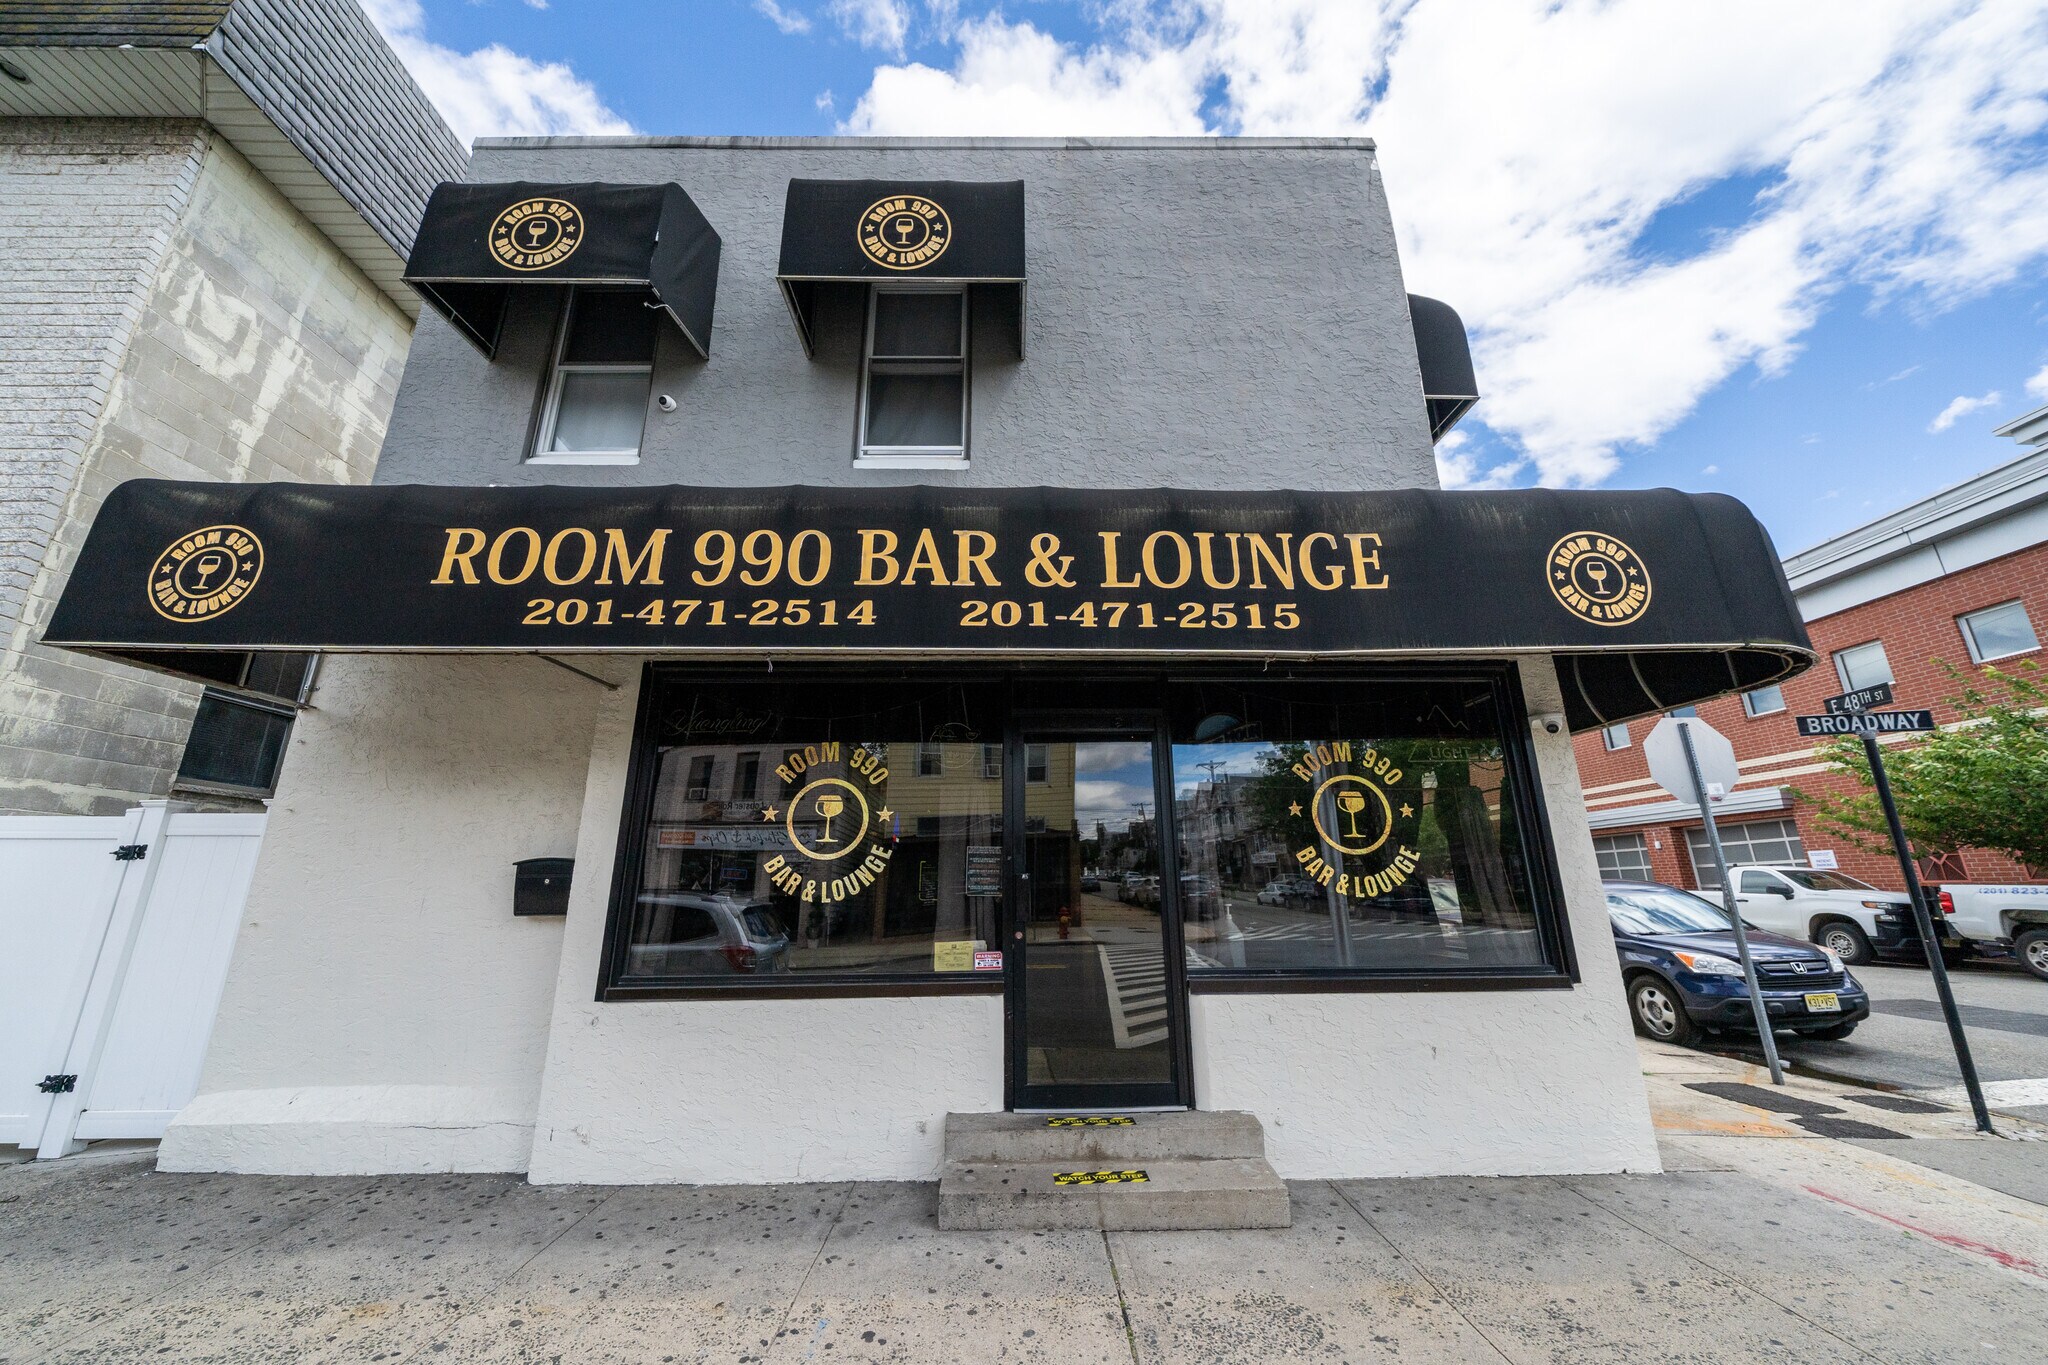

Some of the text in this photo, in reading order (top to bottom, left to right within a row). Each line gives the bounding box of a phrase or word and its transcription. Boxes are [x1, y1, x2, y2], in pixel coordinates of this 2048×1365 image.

[503, 202, 574, 225] ROOM 990
[868, 199, 938, 223] ROOM 990
[494, 236, 576, 266] BAR & LOUNGE
[864, 235, 945, 264] BAR & LOUNGE
[170, 530, 254, 561] ROOM 990
[430, 526, 1390, 590] ROOM 990 BAR & LOUNGE
[1554, 537, 1628, 568] ROOM 990
[155, 577, 251, 615] BAR & LOUNGE
[1559, 582, 1646, 619] BAR & LOUNGE
[521, 598, 1302, 629] 201-471-2514 201-471-2515
[1844, 690, 1872, 711] 48TH
[1875, 690, 1884, 701] ST
[1806, 712, 1920, 733] BROADWAY
[774, 741, 889, 785] ROOM 990
[1291, 741, 1403, 786] ROOM 990
[1429, 746, 1471, 759] LIGHT
[762, 854, 803, 896] BAR
[801, 879, 817, 903] &
[821, 843, 893, 904] LOUNGE
[1295, 844, 1421, 898] BAR & LOUNGE
